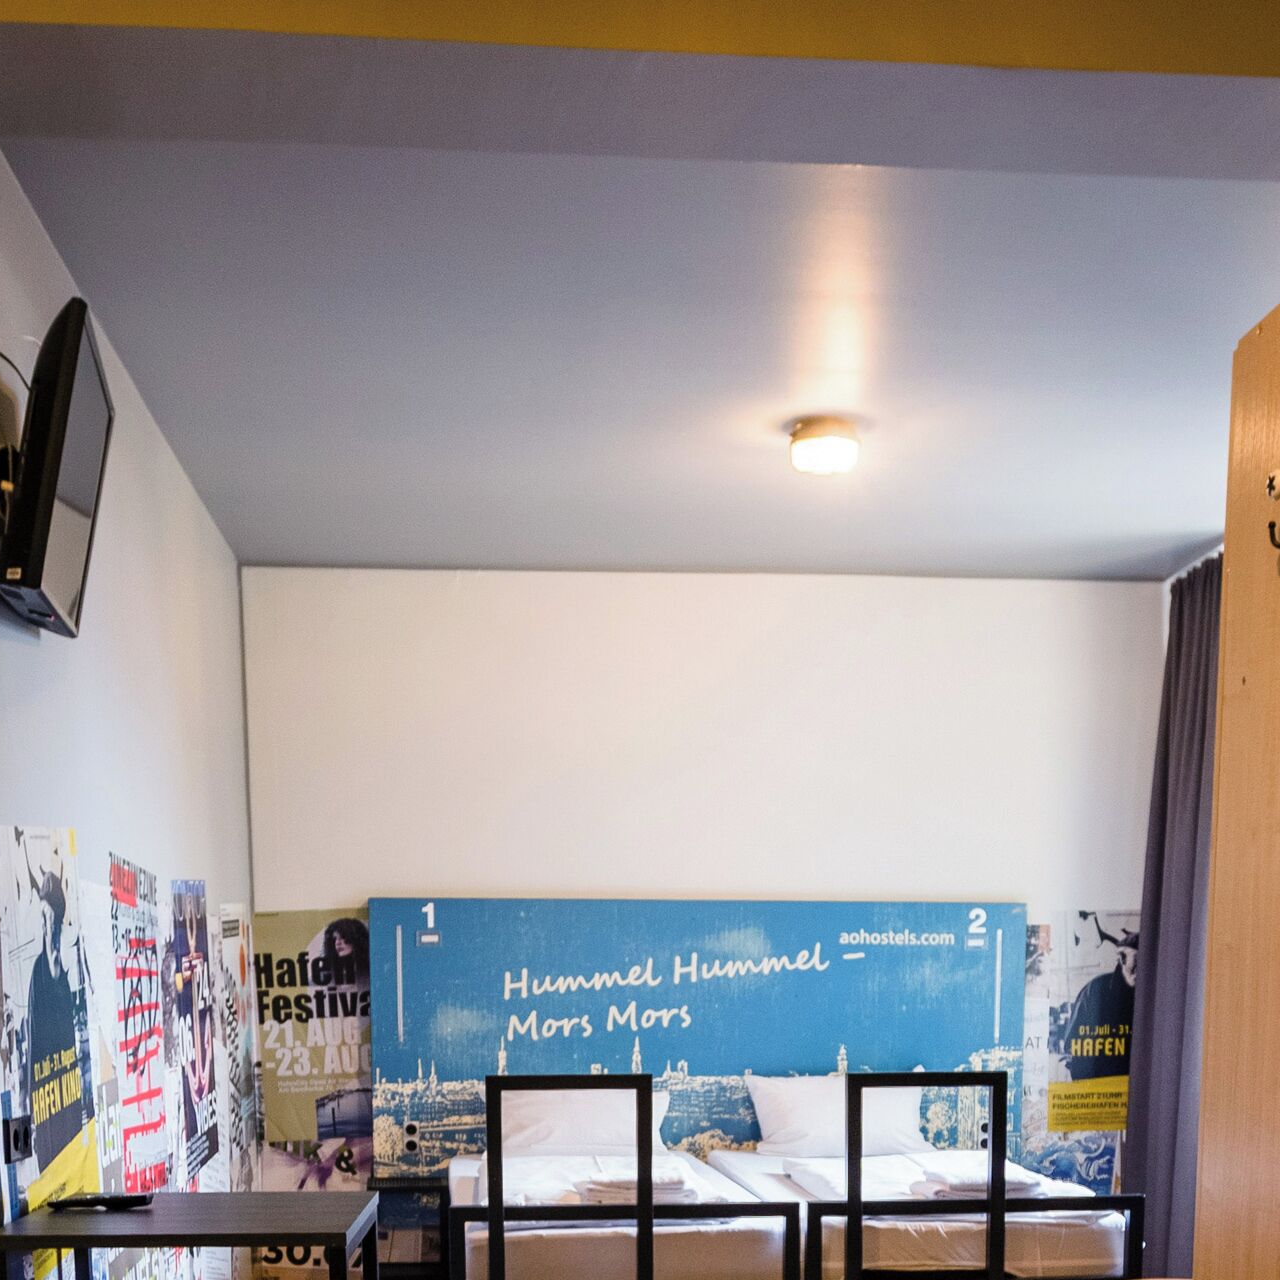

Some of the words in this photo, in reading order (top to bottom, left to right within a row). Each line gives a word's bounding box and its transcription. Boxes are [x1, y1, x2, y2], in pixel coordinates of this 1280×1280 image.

[421, 902, 437, 929] 1
[967, 907, 987, 934] 2
[838, 928, 956, 946] aohostels.com
[253, 951, 357, 988] Hafen
[503, 957, 662, 1001] Hummel
[673, 941, 830, 986] Hummel
[263, 1020, 301, 1049] 21.
[306, 1016, 361, 1047] AUG
[506, 1011, 594, 1042] Mors
[606, 1000, 693, 1032] Mors
[266, 1047, 319, 1077] -23.
[1071, 1037, 1126, 1057] HAFEN
[32, 1081, 61, 1126] HAFEN
[61, 1066, 82, 1110] KINO
